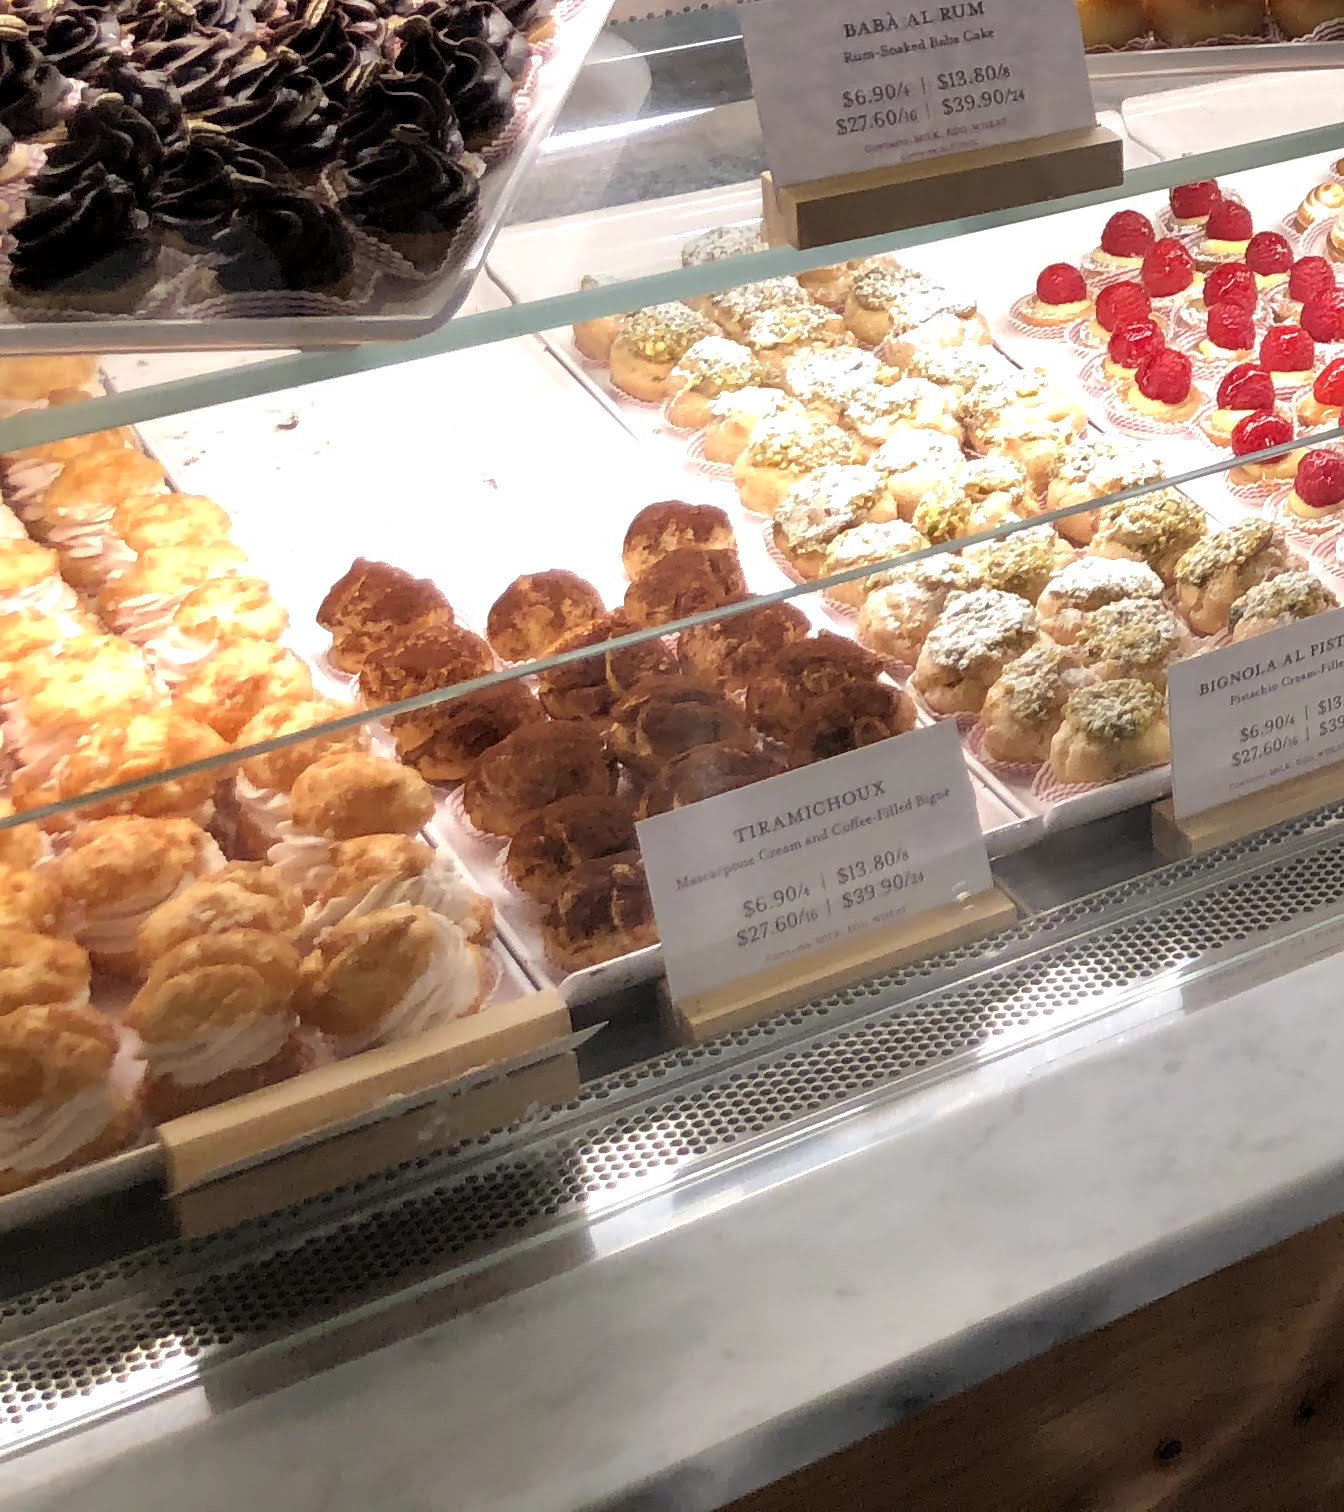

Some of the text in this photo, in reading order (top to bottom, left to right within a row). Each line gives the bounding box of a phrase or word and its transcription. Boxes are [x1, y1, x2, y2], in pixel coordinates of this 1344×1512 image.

[843, 0, 985, 38] BABÀ AL RUM
[843, 38, 927, 64] Rum-Soaked
[963, 27, 995, 43] Cake
[842, 63, 1011, 108] $6.90/4 $13.80/8
[836, 88, 1026, 136] $27.60/16 $39.90/24
[1198, 658, 1277, 697] BIGNOLA
[1283, 648, 1306, 667] AL
[1229, 683, 1279, 706] Pistachio
[1231, 734, 1298, 768] $27.60/16
[1239, 713, 1295, 743] $6.90/4
[732, 779, 887, 844] TIRAMICHOUX
[675, 856, 756, 890] Mascarpone
[758, 840, 803, 861] Cream
[805, 828, 829, 846] and
[831, 801, 913, 836] Coffee-Filled
[742, 847, 910, 918] $6.90/4 $13.80/8
[736, 909, 819, 948] $27.60/16
[842, 871, 926, 909] $39.90/24
